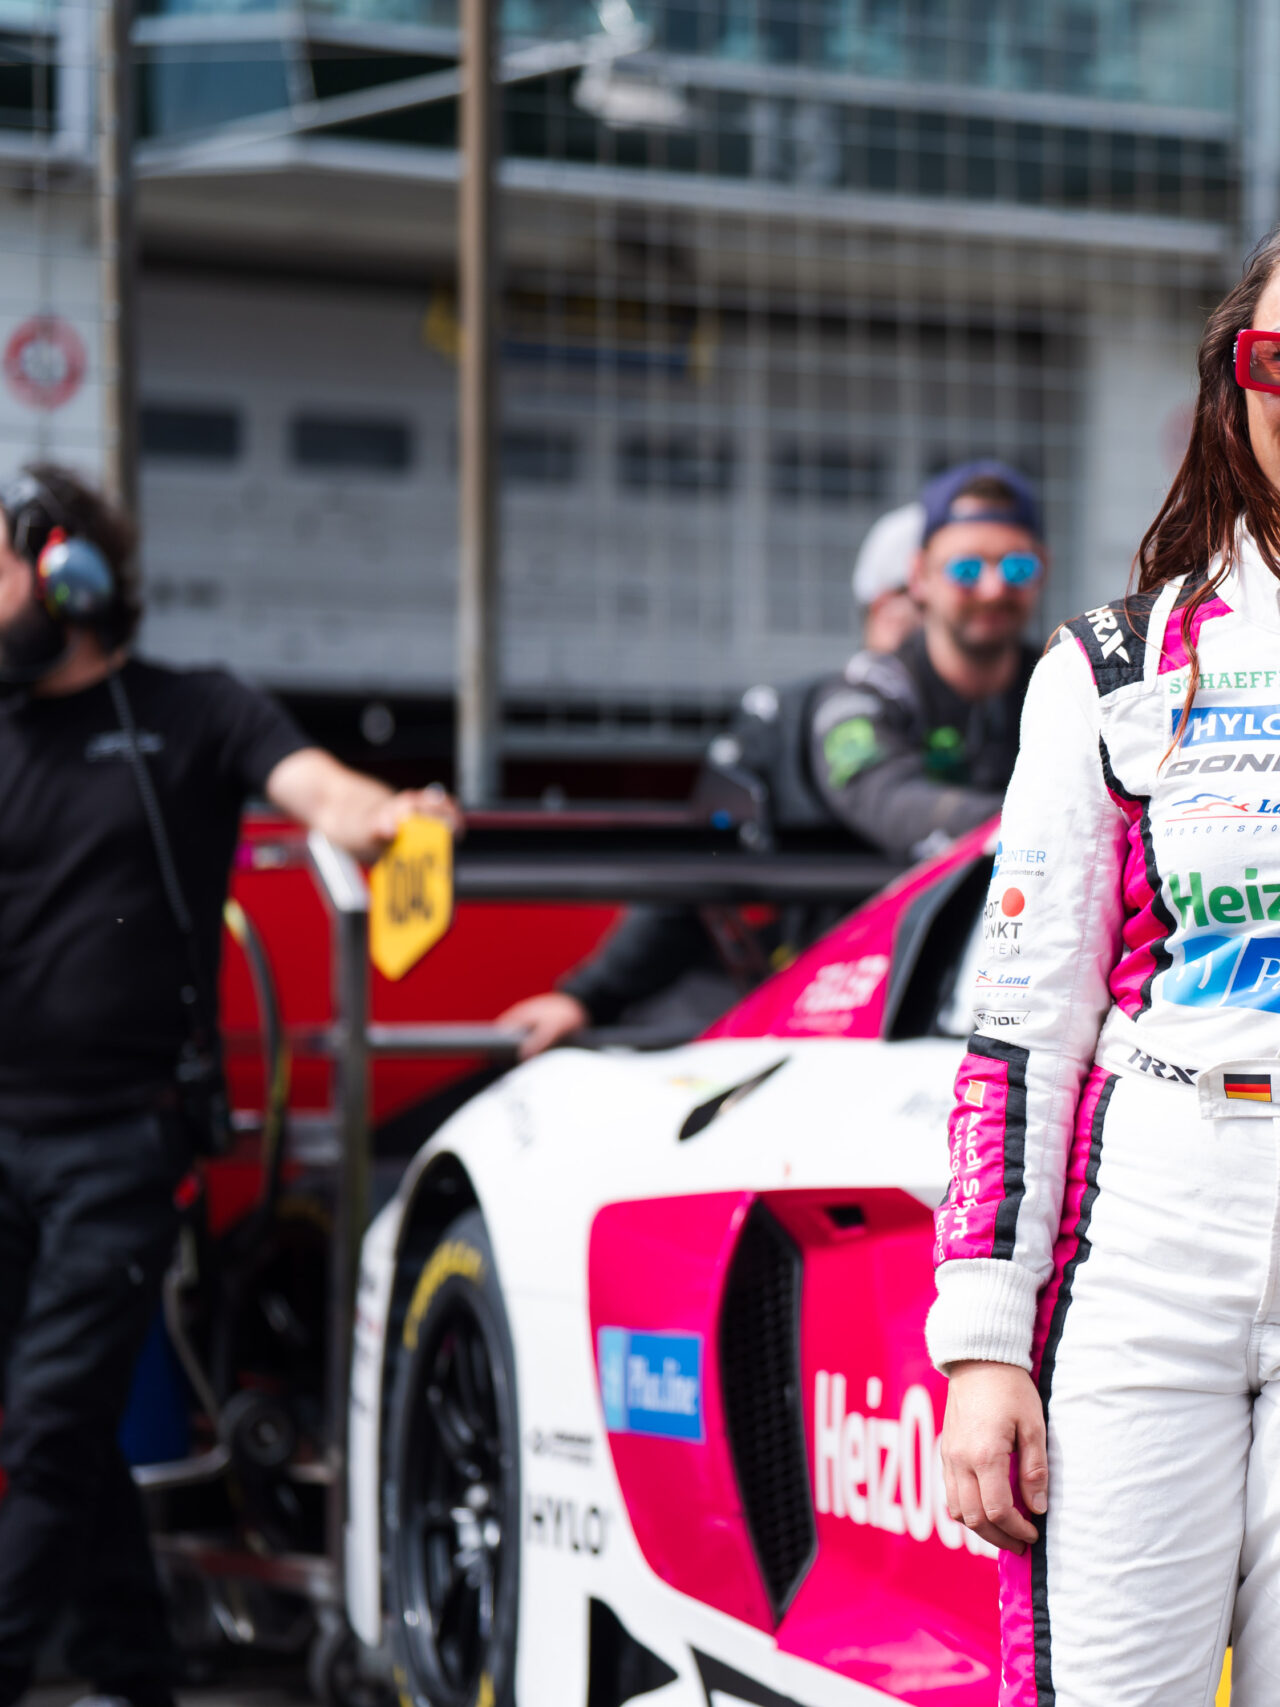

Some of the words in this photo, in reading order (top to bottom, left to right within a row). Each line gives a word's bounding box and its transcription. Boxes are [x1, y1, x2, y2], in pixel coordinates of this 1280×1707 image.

[1084, 604, 1130, 664] HRX
[984, 921, 1023, 940] UNKT
[997, 974, 1031, 985] Land
[1128, 1048, 1199, 1086] HRX
[965, 1112, 982, 1173] Audi
[815, 1369, 998, 1560] HeizO
